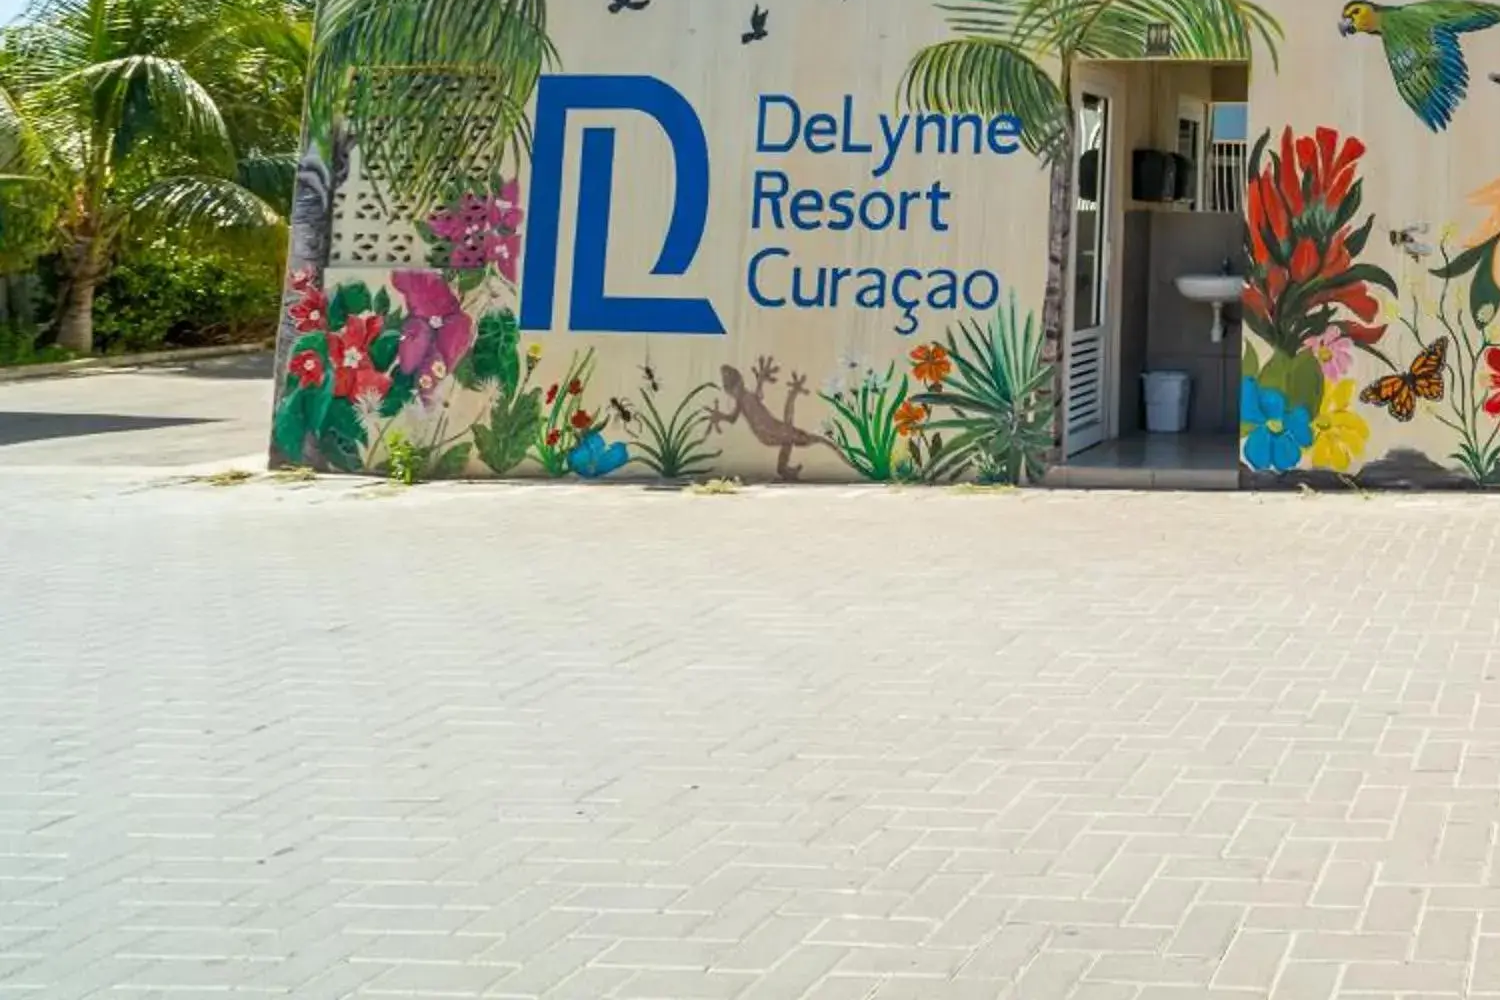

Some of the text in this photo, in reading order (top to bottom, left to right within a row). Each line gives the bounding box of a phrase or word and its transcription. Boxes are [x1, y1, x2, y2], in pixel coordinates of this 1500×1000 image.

[755, 94, 1023, 178] DeLynne
[751, 169, 951, 232] Resort
[746, 247, 1000, 336] Curaçao
